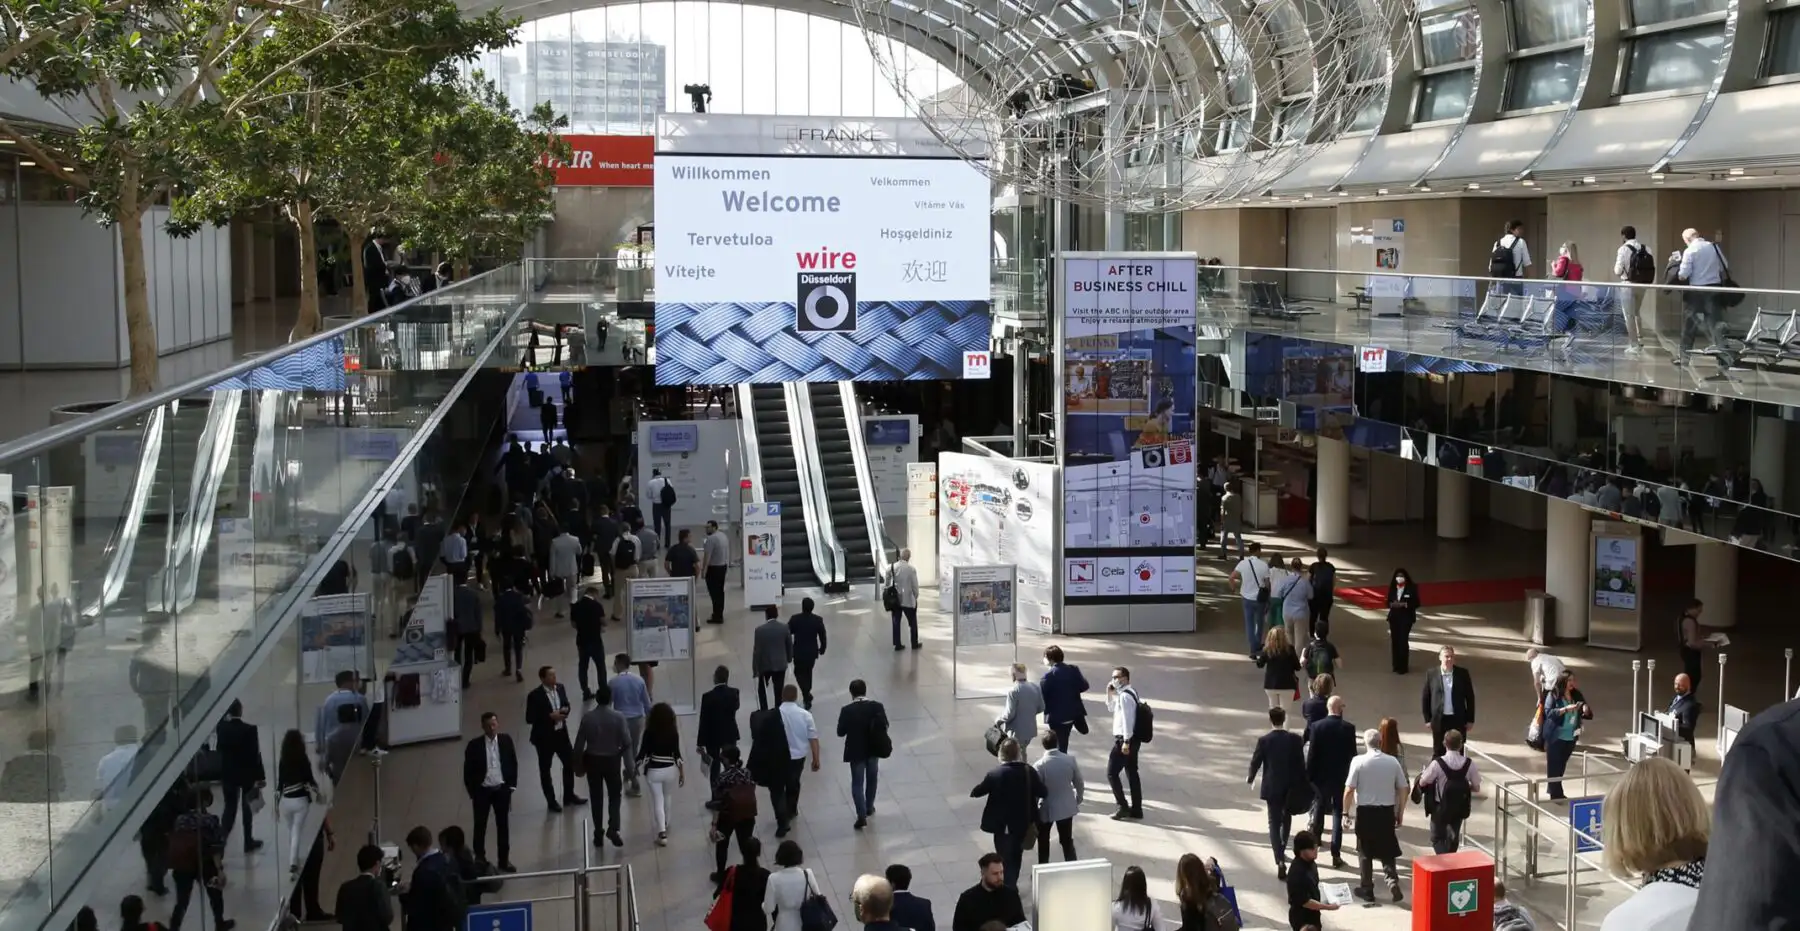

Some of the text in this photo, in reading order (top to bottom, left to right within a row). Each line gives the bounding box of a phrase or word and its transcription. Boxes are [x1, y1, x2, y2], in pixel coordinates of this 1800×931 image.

[799, 128, 882, 142] FRANKE
[621, 161, 640, 169] heart
[672, 166, 770, 181] Willkommen
[870, 177, 930, 187] Velkommen
[722, 191, 840, 212] Welcome
[949, 201, 965, 209] Vás
[687, 233, 773, 246] Tervetuloa
[881, 228, 953, 243] Hoşgeldiniz
[796, 246, 857, 269] wire
[665, 265, 716, 280] Vítejte
[902, 260, 947, 283] 欢迎
[1108, 265, 1153, 276] AFTER
[801, 274, 853, 285] Düsseldorf
[1074, 281, 1187, 292] BUSINESS CHILL
